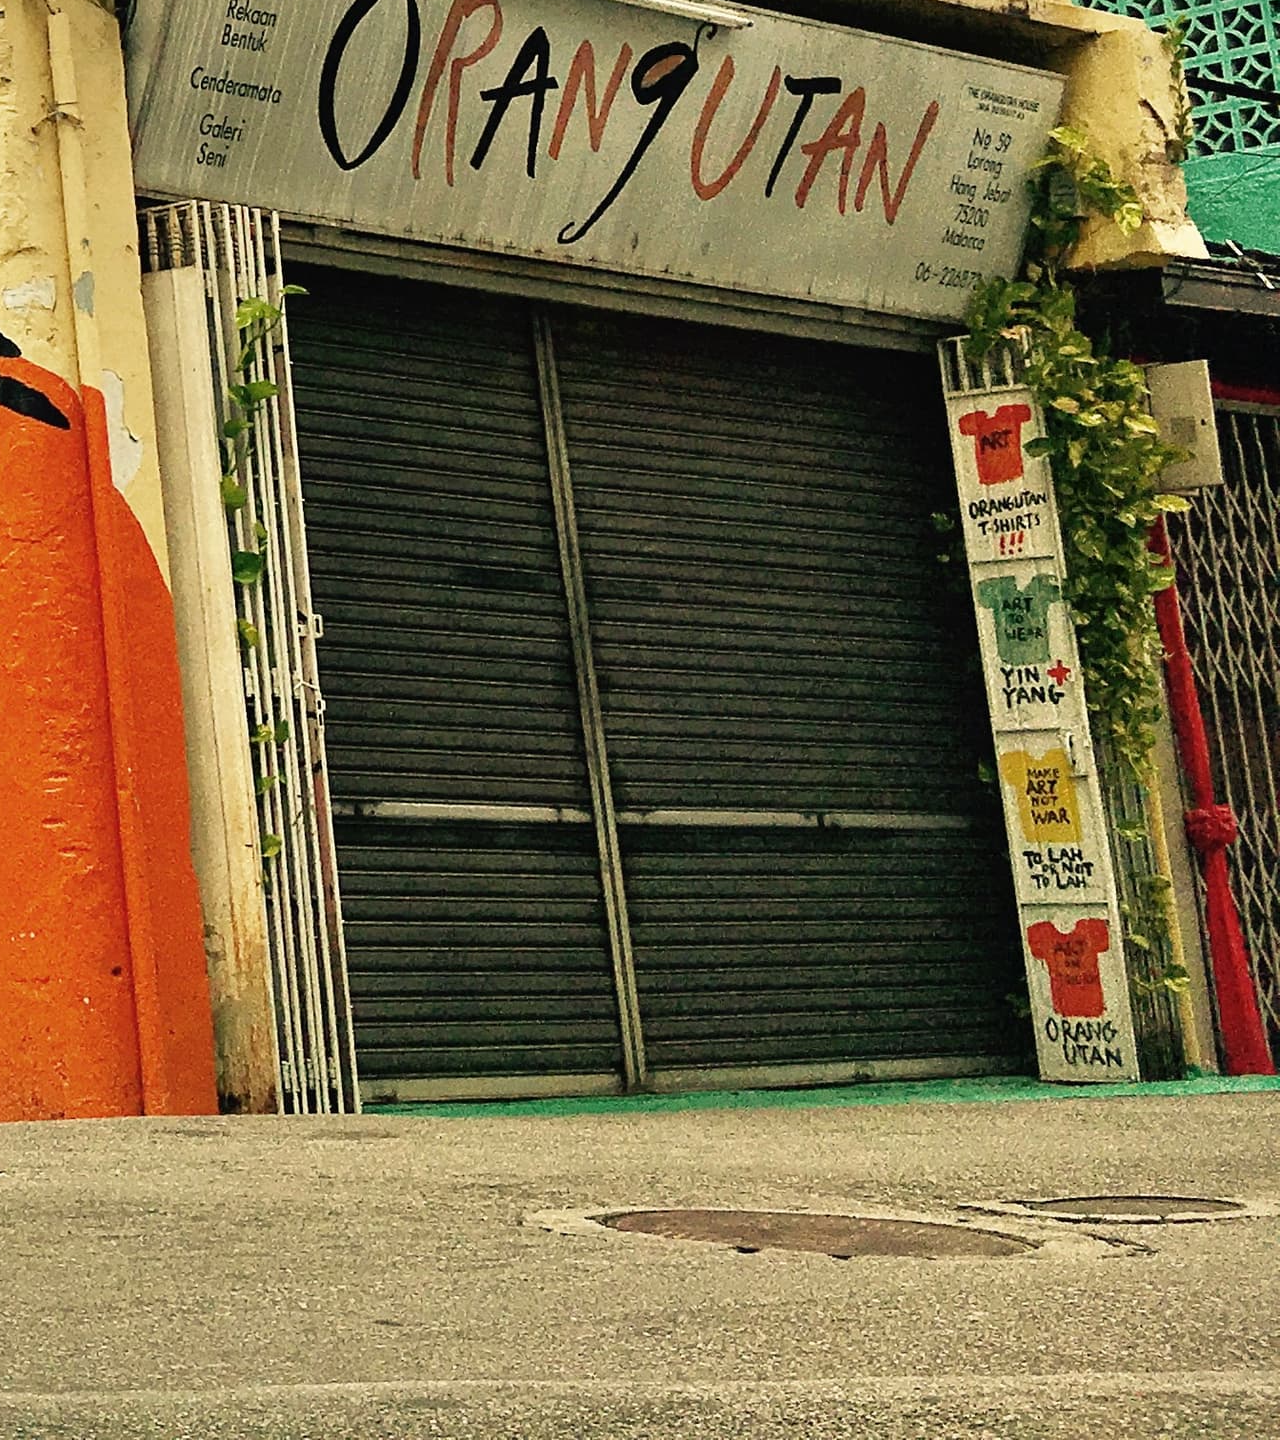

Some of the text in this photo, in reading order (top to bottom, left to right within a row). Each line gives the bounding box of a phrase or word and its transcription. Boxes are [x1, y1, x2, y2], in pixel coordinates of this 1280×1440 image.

[221, 23, 268, 53] Bentuk
[190, 66, 282, 104] Cenderamata
[200, 113, 246, 142] Galeri
[196, 141, 229, 168] Seni
[950, 174, 1013, 204] Hang Jebat
[954, 203, 990, 228] 75200
[981, 428, 1012, 454] ART
[969, 489, 1048, 520] ORANGUTAN
[978, 513, 1041, 536] T-SHIRTS
[1003, 596, 1034, 613] ART
[1000, 666, 1040, 688] YIN
[1002, 684, 1065, 709] YANG
[1026, 767, 1060, 779] MAKE
[1026, 779, 1058, 796] ART
[1031, 796, 1059, 807] NOT
[1031, 807, 1071, 825] WAR
[1022, 847, 1083, 869] TO LAH
[1042, 861, 1094, 877] OR NOT
[1030, 873, 1087, 890] TO LAH
[1045, 1017, 1118, 1044] ORANG
[1062, 1043, 1123, 1068] UTAN
